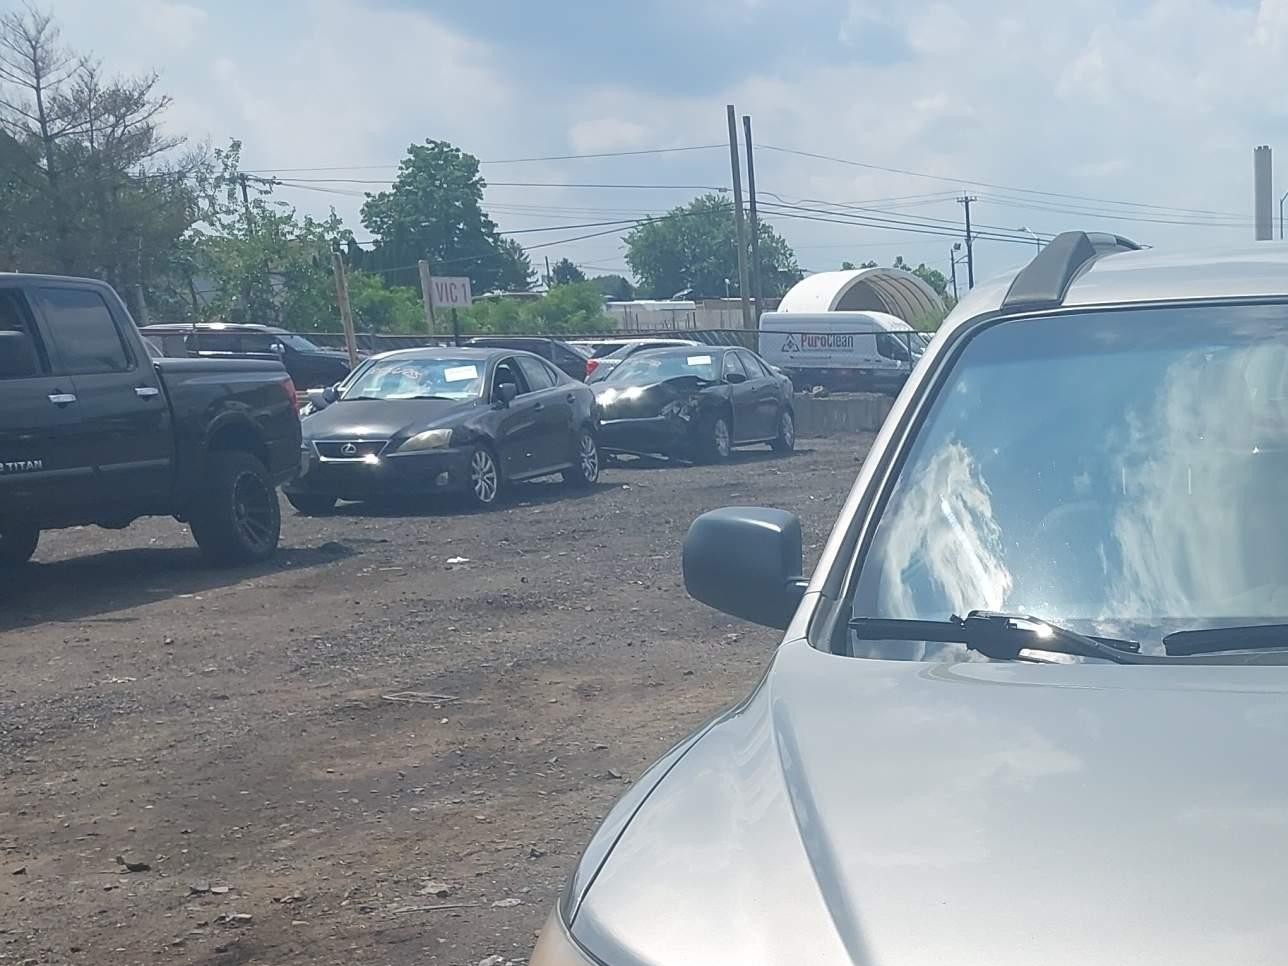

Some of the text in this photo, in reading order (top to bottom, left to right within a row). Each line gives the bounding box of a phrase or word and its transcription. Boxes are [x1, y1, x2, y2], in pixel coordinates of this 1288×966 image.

[435, 282, 468, 303] VIC 1
[801, 334, 854, 348] PuroClean
[5, 460, 42, 471] TITAN
